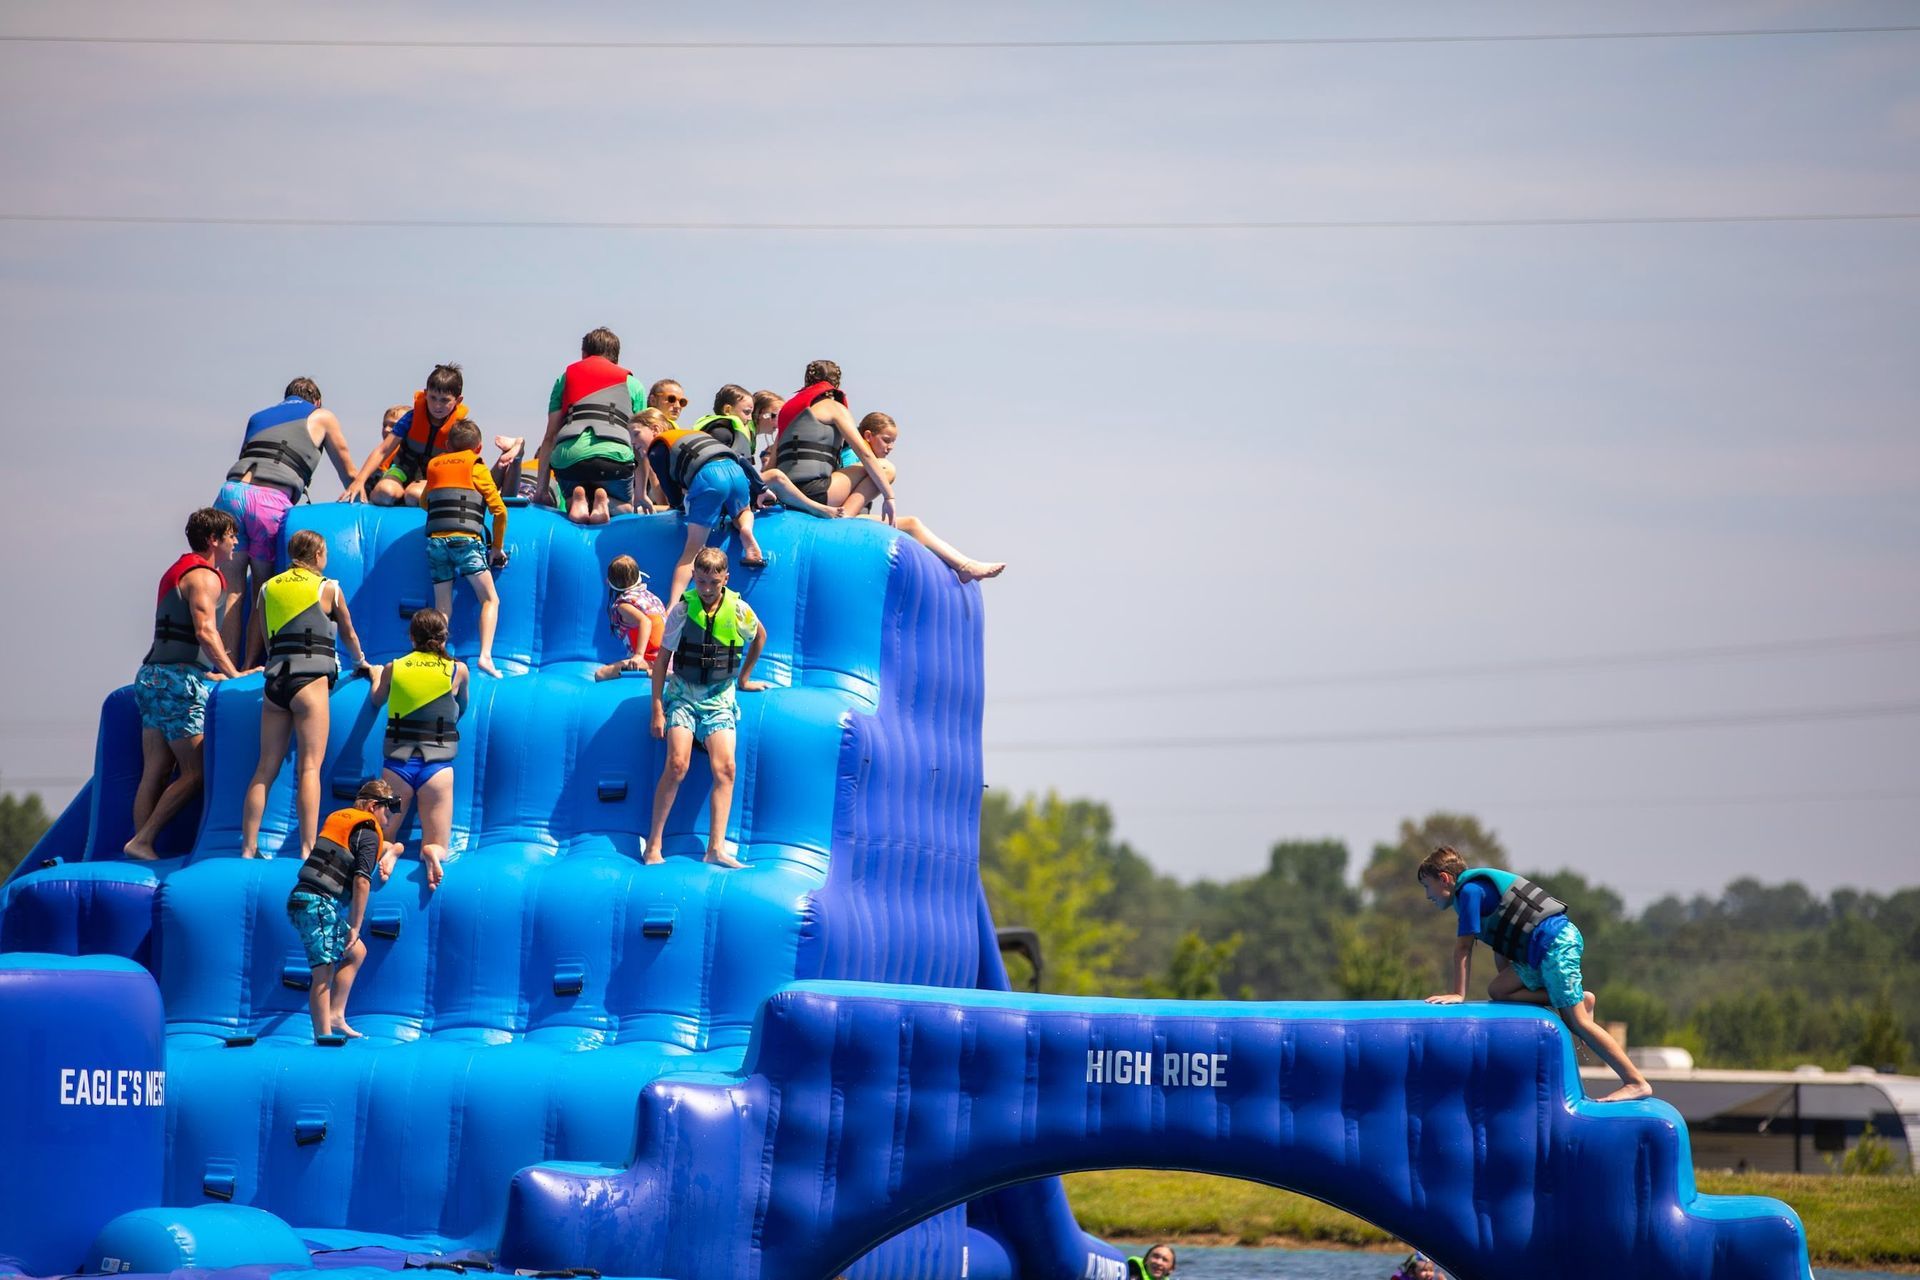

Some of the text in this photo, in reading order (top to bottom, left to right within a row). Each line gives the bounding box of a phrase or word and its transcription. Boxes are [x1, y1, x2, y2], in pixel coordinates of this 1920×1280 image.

[1086, 1050, 1228, 1087] HIGH RISE
[60, 1069, 166, 1106] EAGLE'S NEST
